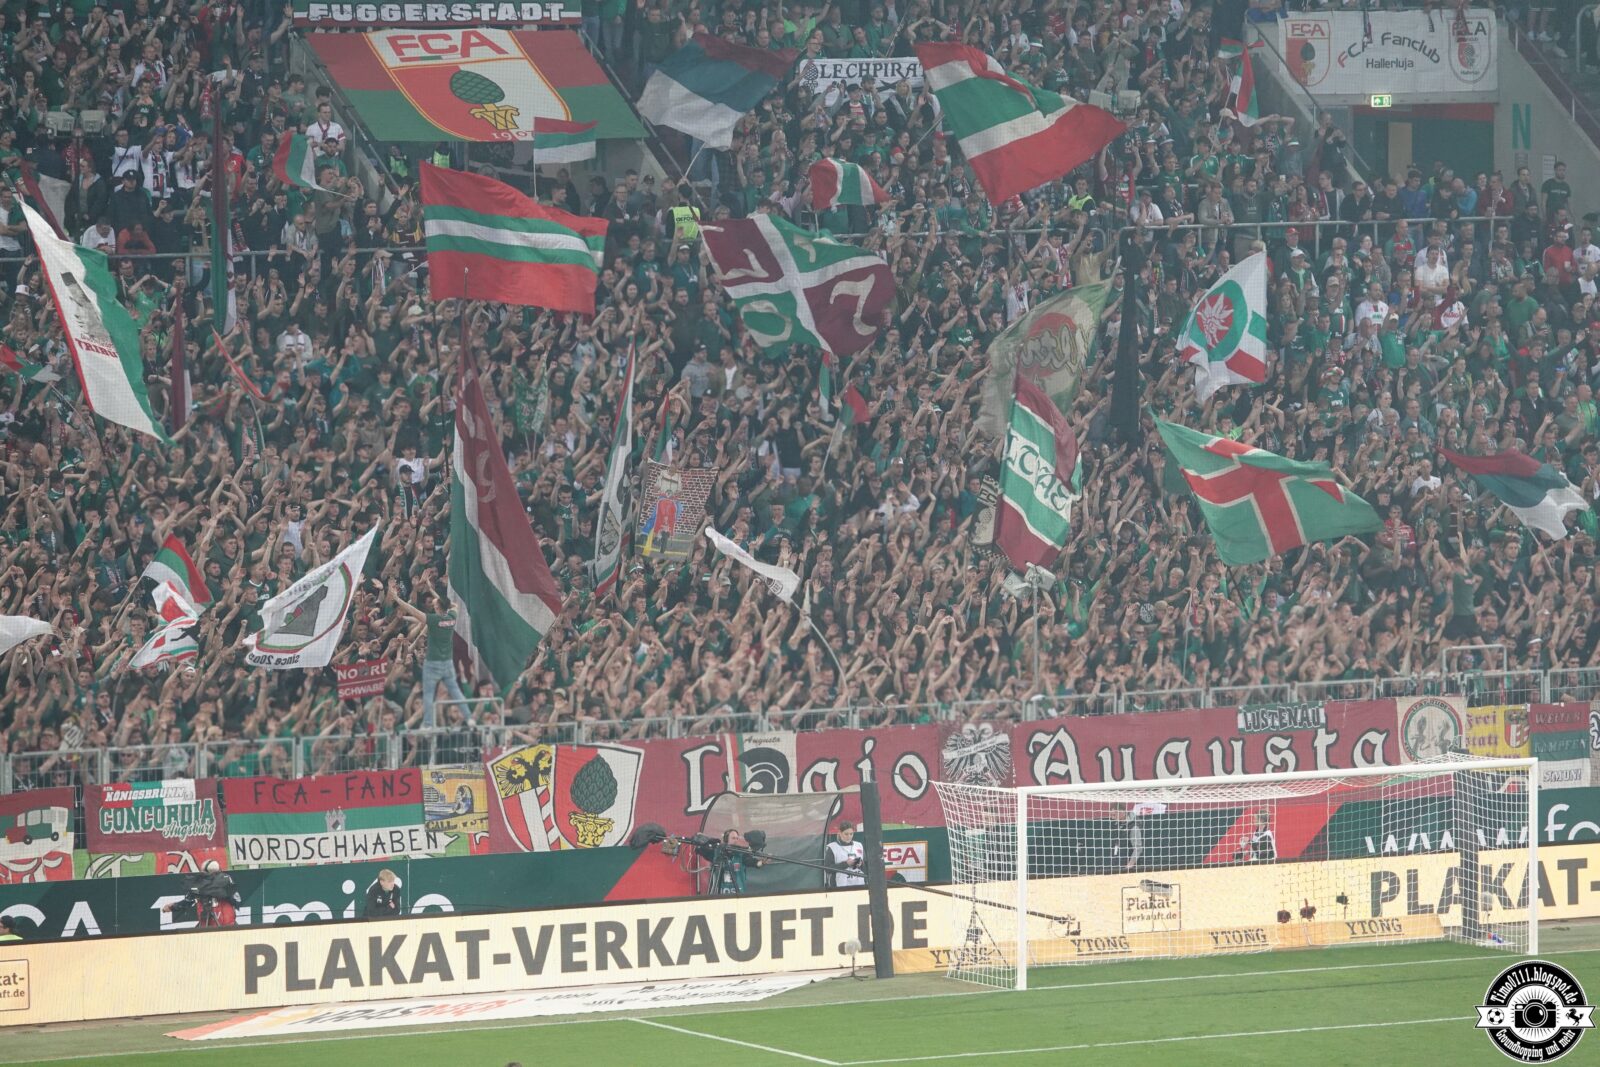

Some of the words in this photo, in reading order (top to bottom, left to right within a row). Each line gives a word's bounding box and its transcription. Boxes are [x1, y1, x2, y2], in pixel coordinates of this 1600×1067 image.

[307, 2, 565, 22] FUGGERSTADT
[387, 30, 509, 57] FCA
[1290, 23, 1325, 37] FCA
[1380, 32, 1441, 64] Fanclub
[1366, 58, 1414, 70] Hallerluja
[1511, 103, 1531, 149] N
[1243, 703, 1323, 731] LUSTENAU
[744, 735, 781, 746] Augusta
[1027, 724, 1390, 787] Augusta
[254, 781, 308, 804] FCA
[345, 773, 411, 800] FANS
[682, 737, 929, 819] Lgio
[99, 798, 216, 834] CONCORDIA
[162, 820, 216, 841] Augsburg
[234, 828, 439, 861] NORDSCHWABEN
[1126, 896, 1177, 911] Plakat-
[1209, 928, 1267, 945] YTONG
[1346, 918, 1403, 935] YTONG
[244, 901, 929, 995] PLAKAT-VERKAUFT.DE
[1070, 936, 1130, 953] YTONG
